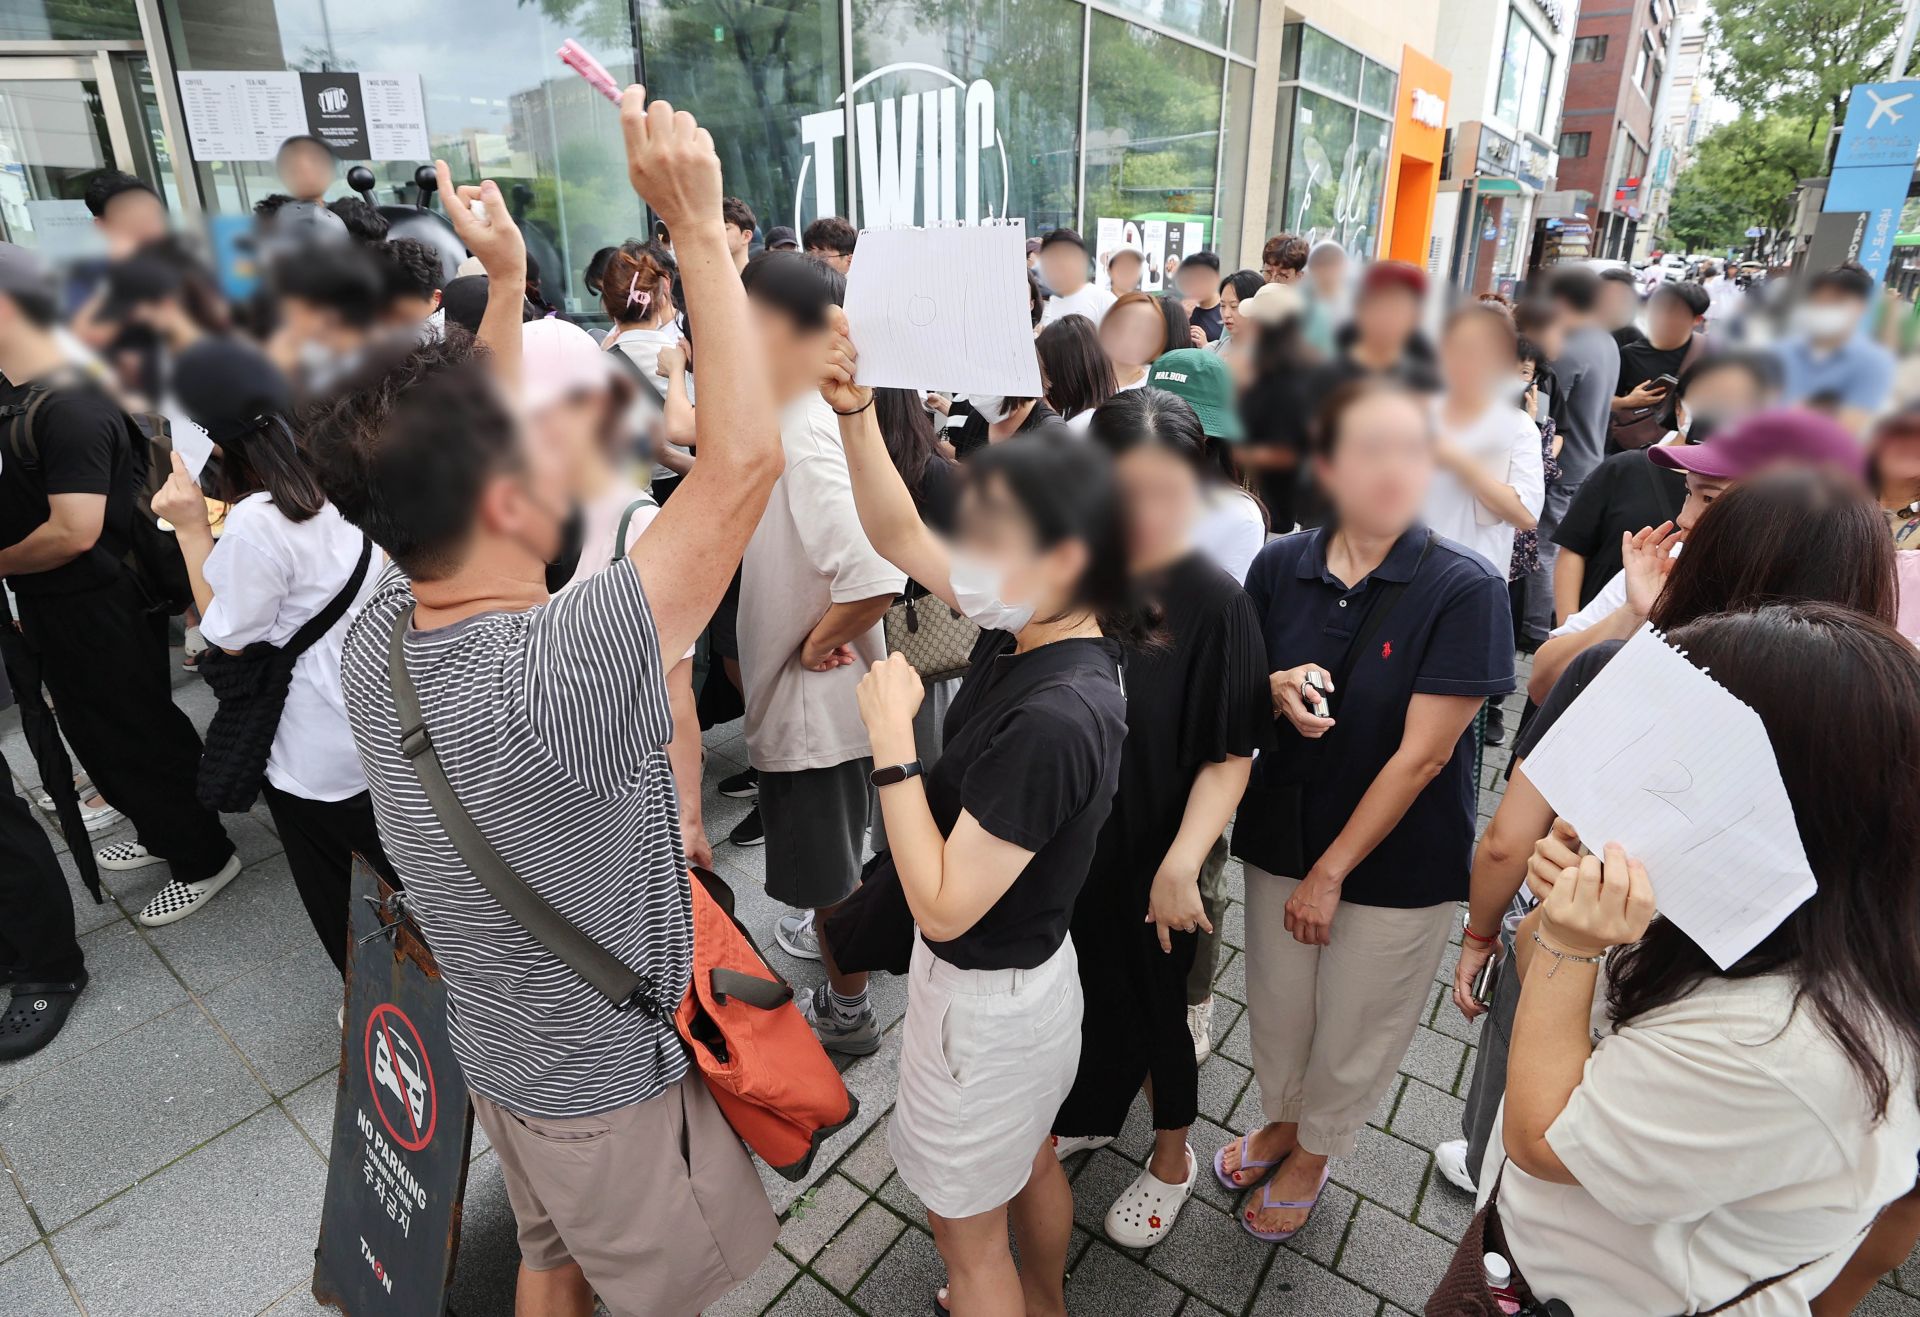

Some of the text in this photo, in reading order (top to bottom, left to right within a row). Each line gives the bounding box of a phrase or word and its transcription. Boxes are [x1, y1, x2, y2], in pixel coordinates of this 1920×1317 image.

[357, 1108, 427, 1210] NO PARKING
[365, 1143, 413, 1214] TOWAWAY ZONE
[363, 1160, 411, 1239] 주차금지
[360, 1235, 393, 1295] TMON
